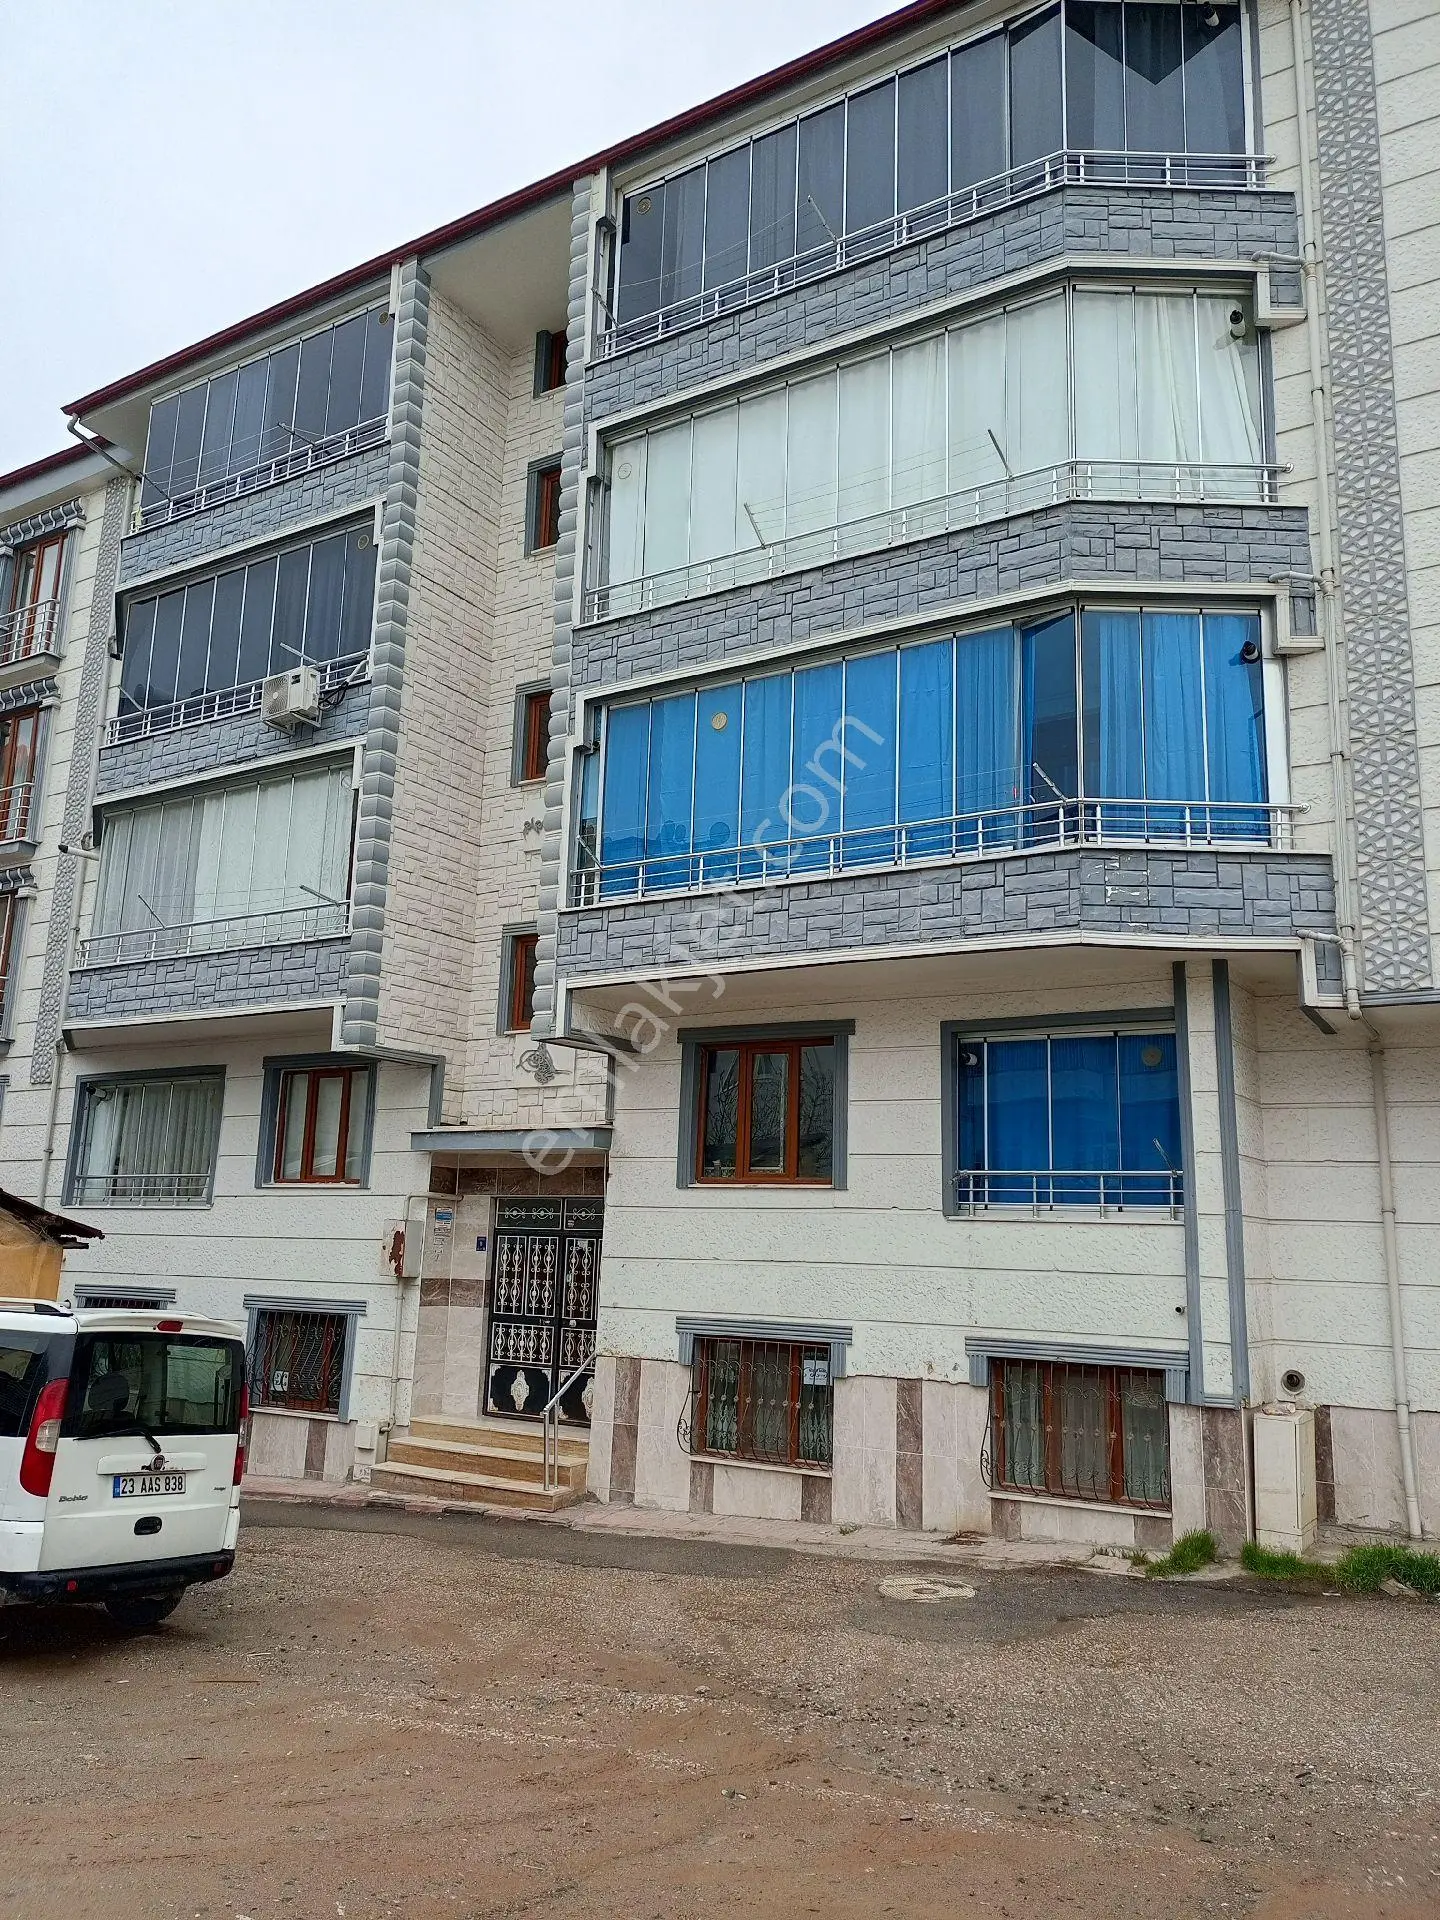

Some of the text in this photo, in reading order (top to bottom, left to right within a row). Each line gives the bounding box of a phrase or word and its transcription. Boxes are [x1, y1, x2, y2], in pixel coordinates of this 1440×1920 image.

[121, 1475, 183, 1494] 23 AAS 838
